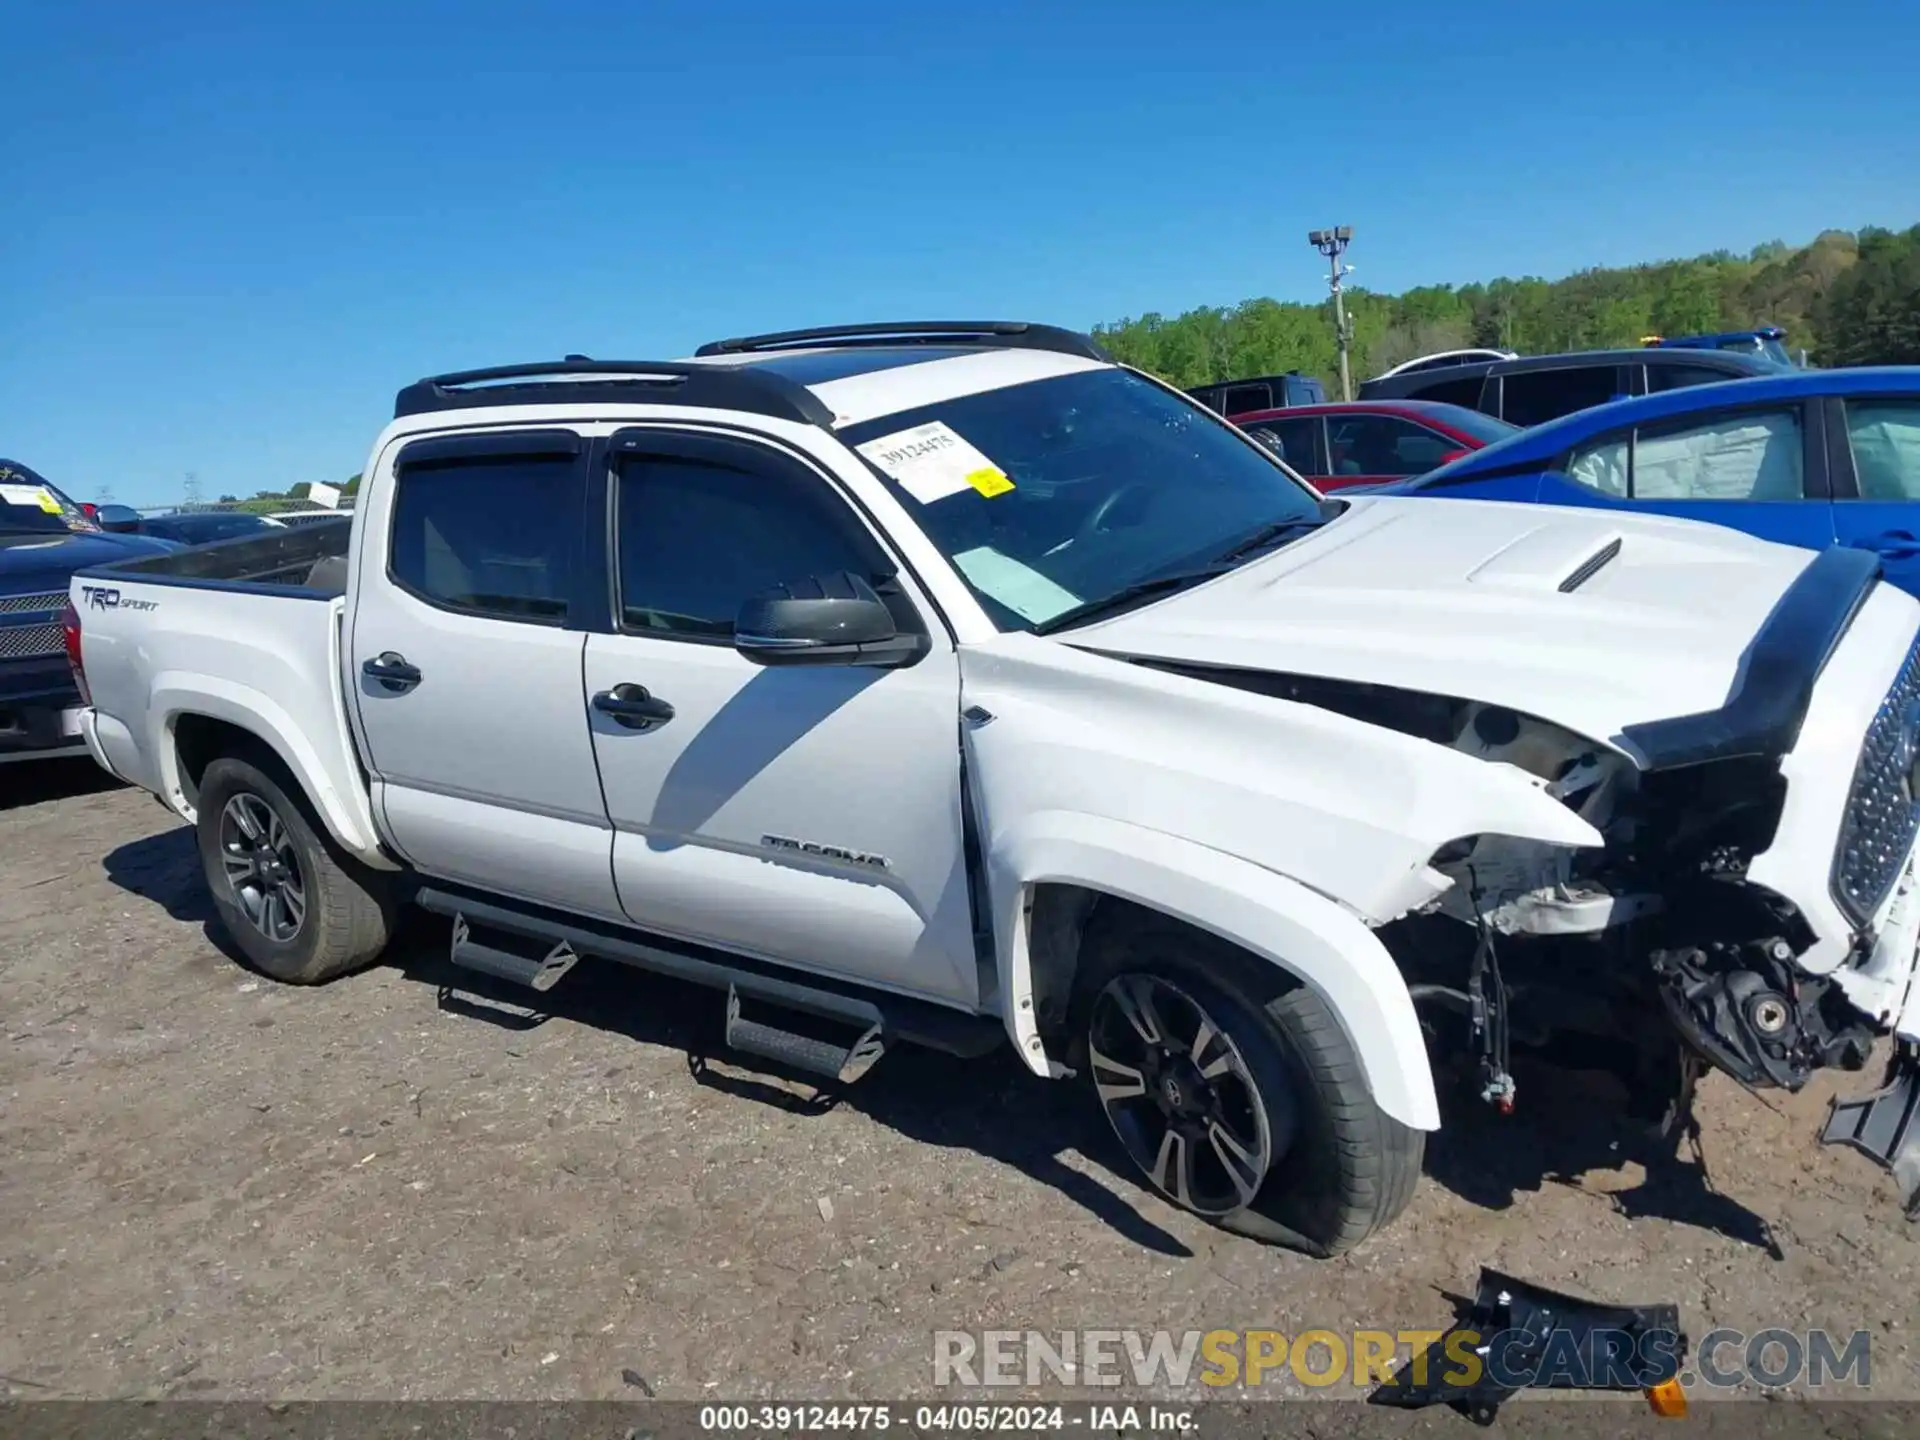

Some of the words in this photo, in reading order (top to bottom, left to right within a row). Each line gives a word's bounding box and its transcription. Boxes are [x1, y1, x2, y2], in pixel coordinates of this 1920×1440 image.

[881, 435, 955, 466] 39124475
[82, 586, 121, 612] TRD
[120, 598, 160, 611] SPORT
[760, 833, 889, 867] TACOMA
